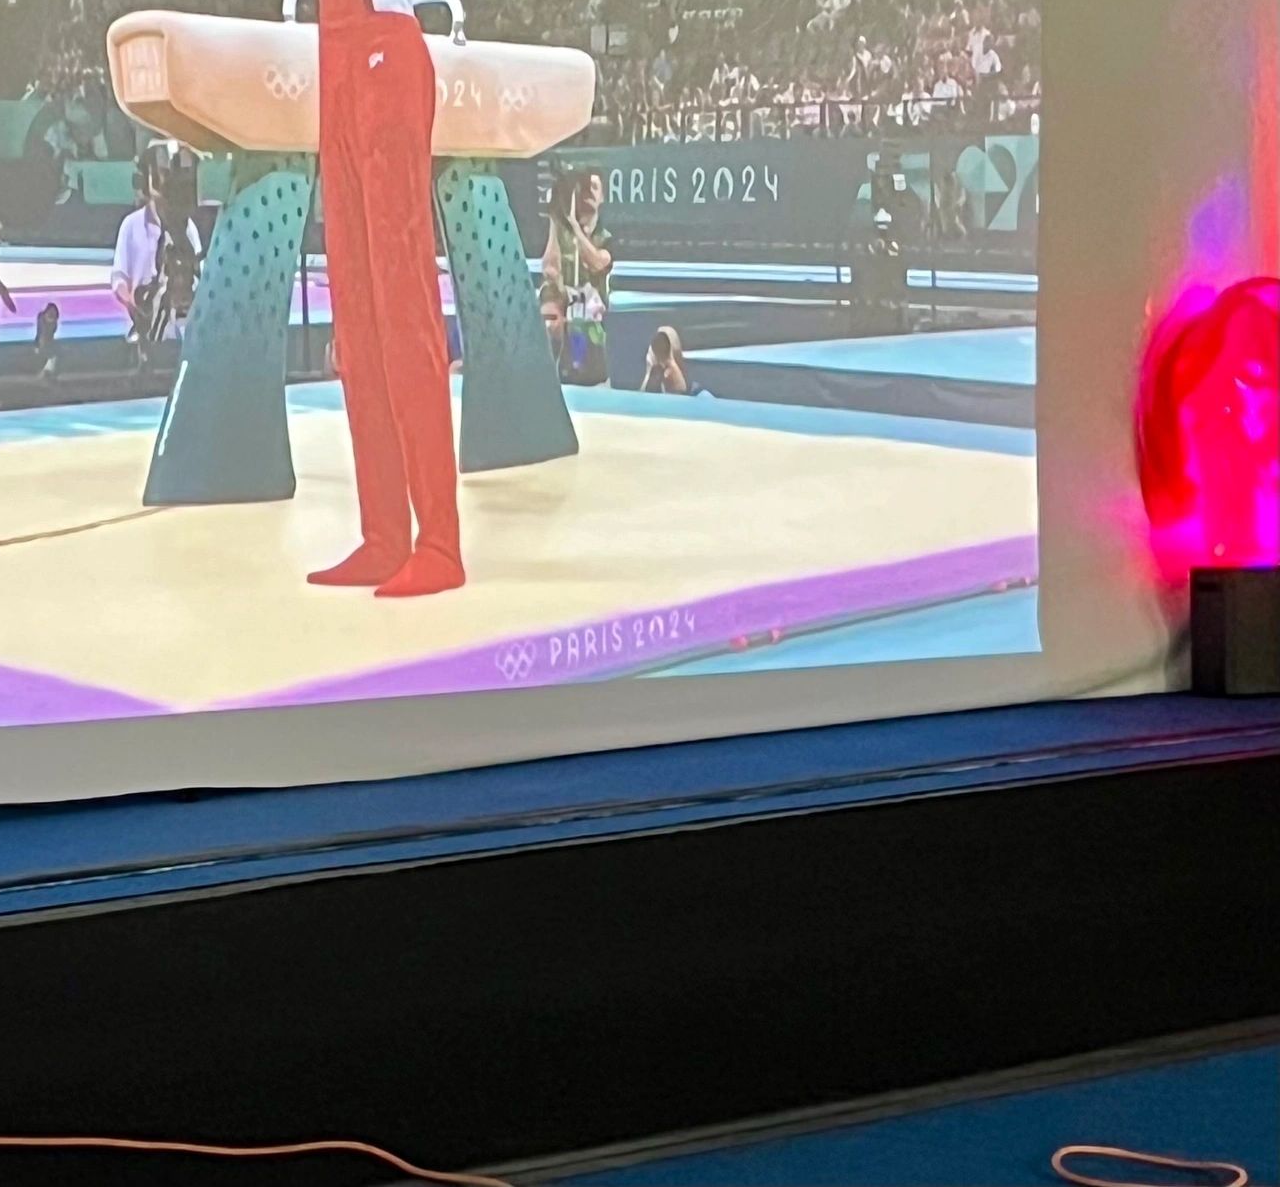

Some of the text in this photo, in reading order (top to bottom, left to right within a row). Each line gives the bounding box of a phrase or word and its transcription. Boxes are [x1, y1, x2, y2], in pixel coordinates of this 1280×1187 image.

[608, 165, 779, 204] ARIS 2024
[549, 609, 696, 668] PARIS 2024
